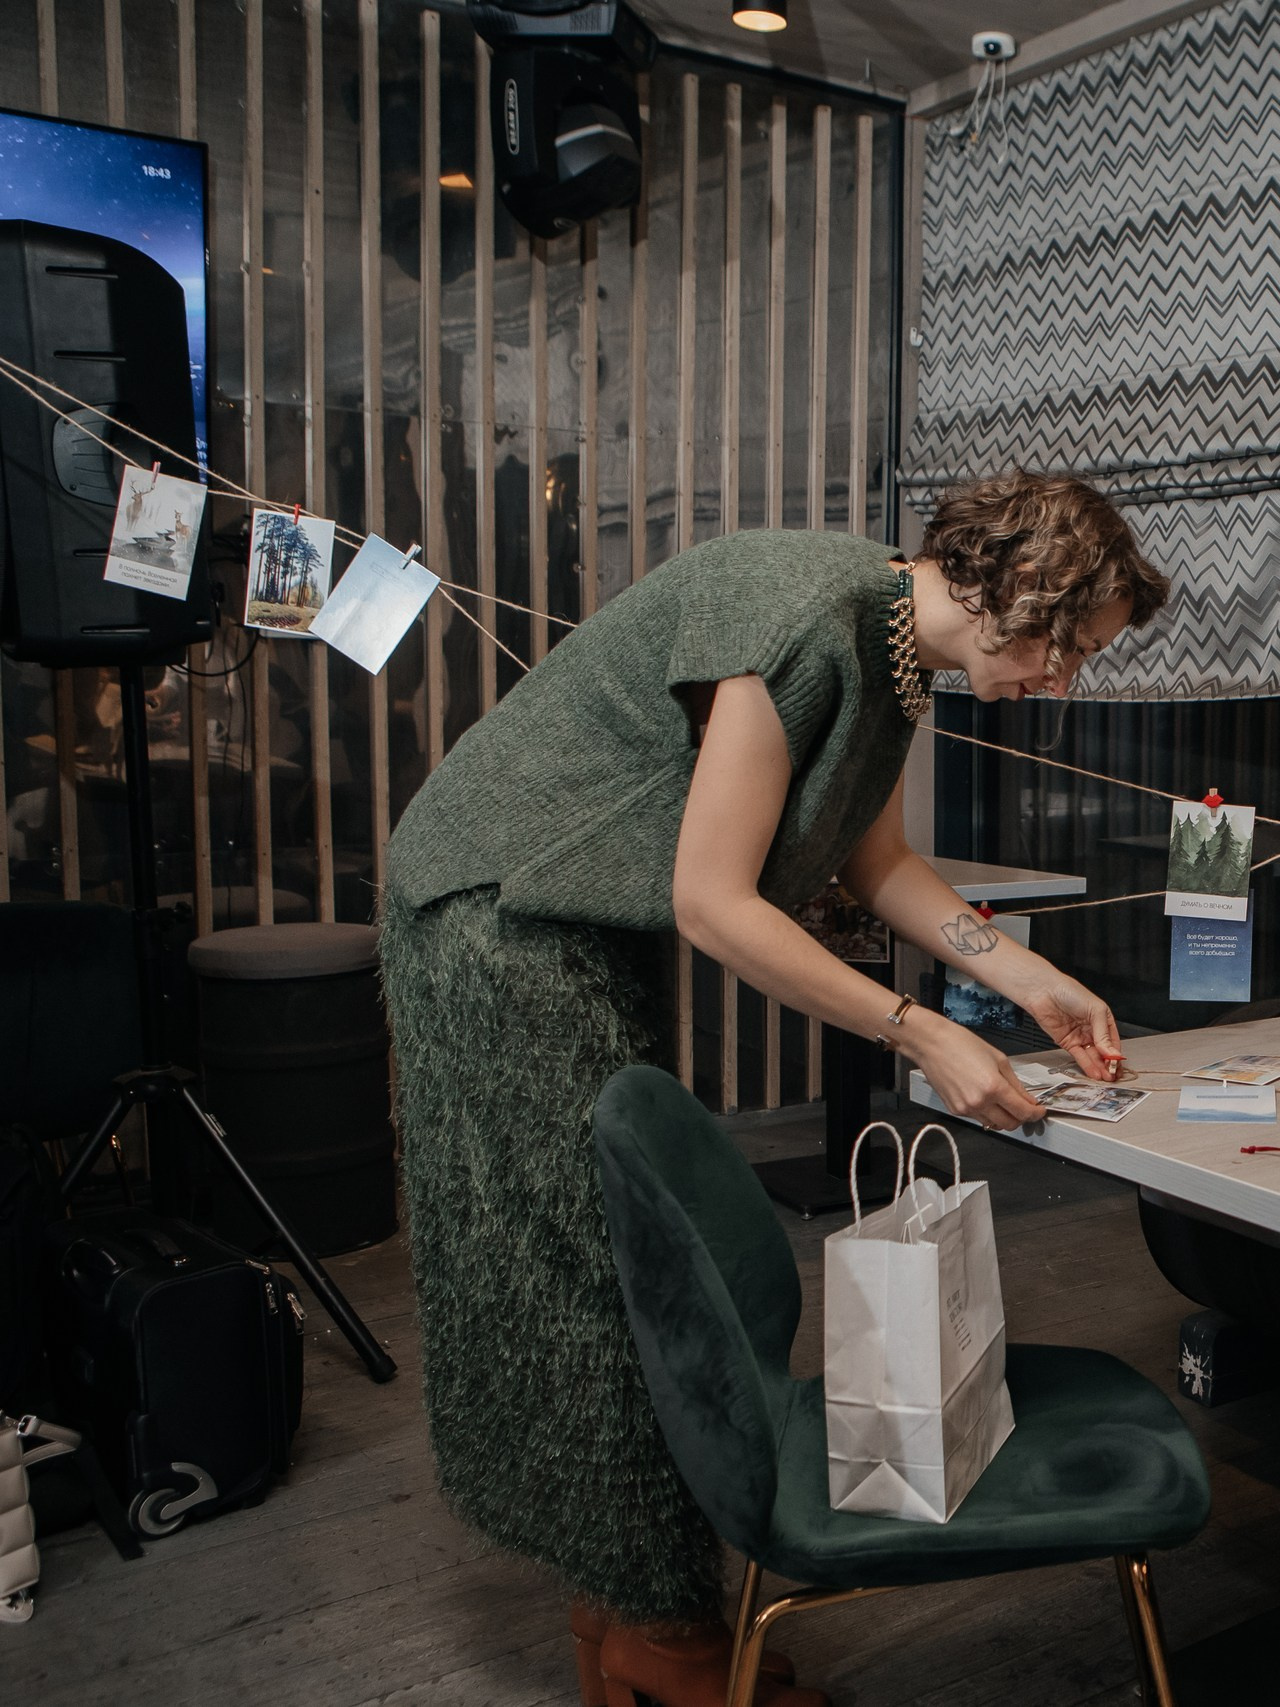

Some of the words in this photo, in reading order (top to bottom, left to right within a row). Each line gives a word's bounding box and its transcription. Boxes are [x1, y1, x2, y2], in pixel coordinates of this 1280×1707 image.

[141, 164, 172, 180] 18:43
[1180, 900, 1203, 908] ДУМАТЬ
[1209, 902, 1233, 910] ВЕЧНОМ
